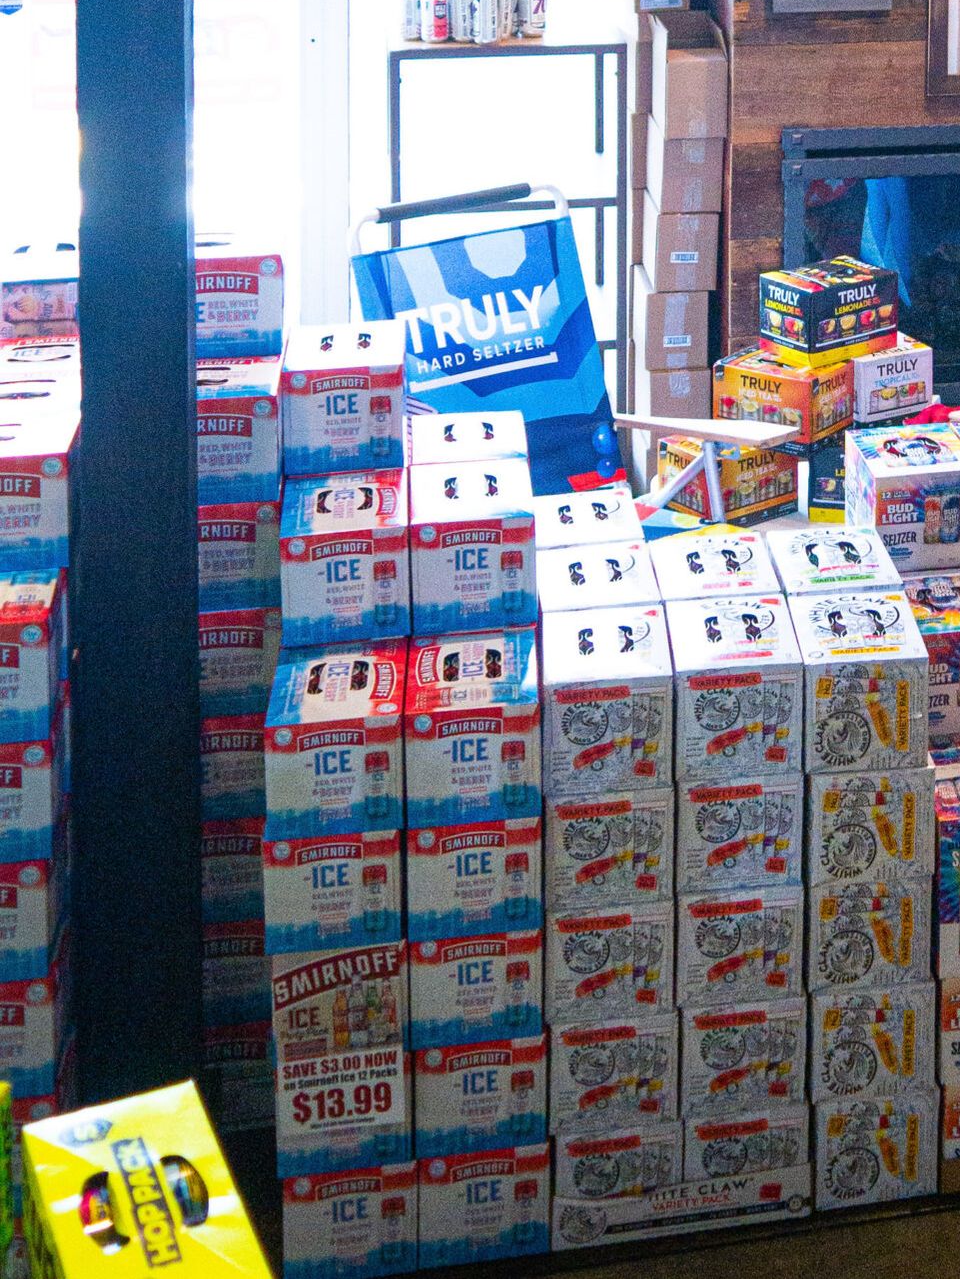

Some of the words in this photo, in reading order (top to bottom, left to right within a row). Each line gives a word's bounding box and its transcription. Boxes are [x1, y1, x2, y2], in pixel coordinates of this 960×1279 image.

[195, 276, 252, 290] IRNOFF
[768, 284, 800, 306] TRULY
[838, 283, 877, 304] TRULY
[216, 309, 259, 322] BERRY
[834, 299, 872, 316] LEMONADE
[395, 285, 544, 354] TRULY
[417, 352, 466, 374] HARD
[473, 336, 545, 362] SELTZER
[877, 358, 919, 377] TRULY
[316, 378, 365, 392] SMIRNOFF
[740, 374, 782, 394] TRULY
[819, 373, 846, 394] TRULY
[326, 393, 359, 415] ICE
[197, 416, 245, 432] RNOFF
[738, 452, 777, 472] TRULY
[882, 511, 918, 524] LIGHT
[887, 503, 914, 513] BUD
[446, 532, 497, 546] SMIRNOFF
[883, 531, 917, 546] SELTZER
[315, 543, 368, 558] SMIRNOFF
[455, 547, 489, 571] ICE
[326, 558, 362, 583] ICE
[200, 629, 262, 645] IRNOFF
[834, 647, 872, 656] VARIETY
[873, 646, 899, 654] PACK
[695, 676, 731, 688] VARIETY
[733, 674, 758, 685] PACK
[898, 681, 908, 708] PACK
[442, 720, 498, 735] SMIRNOFF
[898, 709, 908, 747] VARIETY
[303, 732, 360, 748] SMIRNOFF
[452, 738, 489, 763] ICE
[314, 750, 351, 775] ICE
[445, 834, 501, 849] SMIRNOFF
[301, 847, 358, 862] SMIRNOFF
[455, 852, 492, 877] ICE
[312, 863, 349, 888] ICE
[447, 943, 502, 959] SMIRNOFF
[275, 951, 398, 1003] SMIRNOFF
[288, 1006, 321, 1030] ICE
[282, 1061, 317, 1080] SAVE
[321, 1055, 360, 1074] $3.00
[364, 1049, 397, 1068] NOW
[284, 1081, 296, 1091] on
[298, 1074, 339, 1090] Smirnoff
[370, 1067, 398, 1079] Packs
[292, 1081, 392, 1125] $13.99
[698, 1178, 748, 1196] CLAW
[652, 1198, 698, 1212] VARIETY
[137, 1203, 181, 1265] HOP
